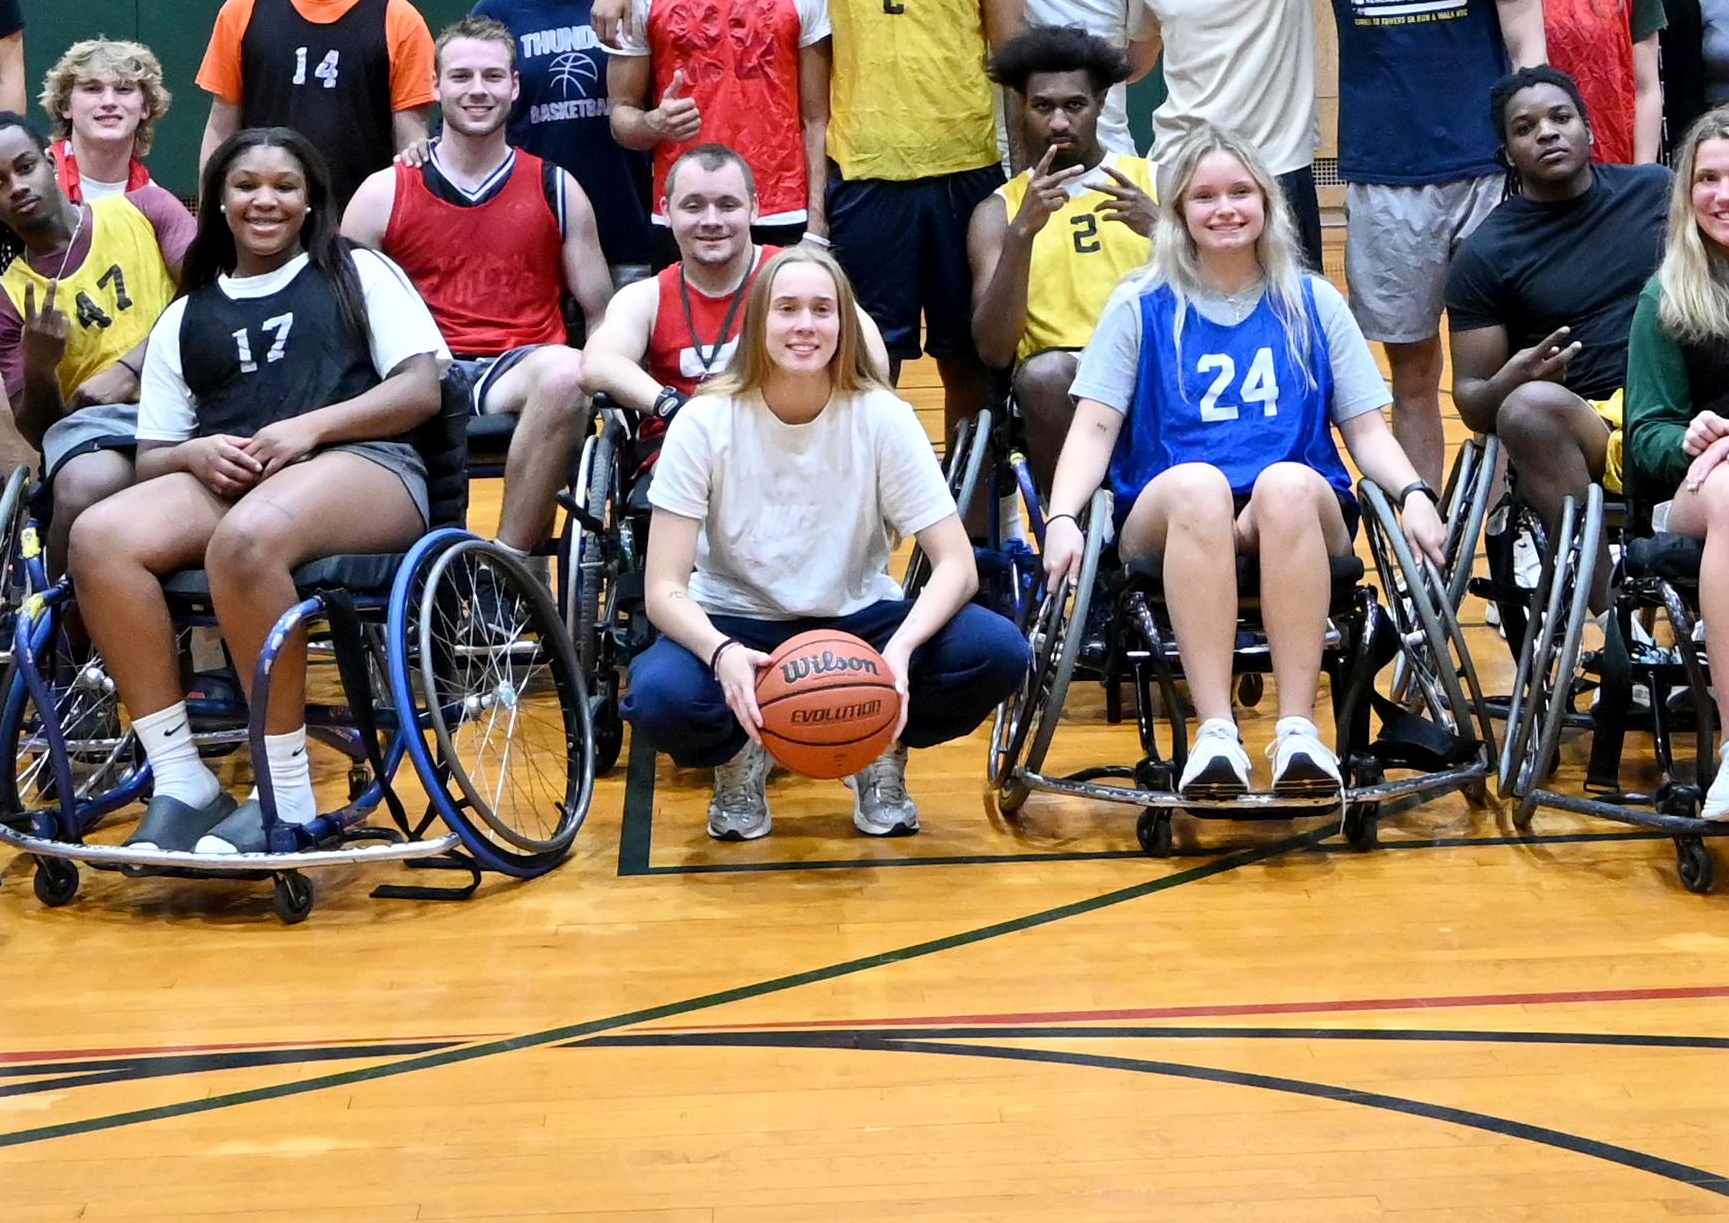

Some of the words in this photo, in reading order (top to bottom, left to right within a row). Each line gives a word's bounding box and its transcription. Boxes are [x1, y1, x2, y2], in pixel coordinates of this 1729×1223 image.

[520, 25, 596, 58] THUND
[292, 46, 339, 88] 14
[530, 98, 609, 124] BASKETBA
[1070, 213, 1101, 253] 2
[75, 263, 133, 329] 47
[232, 311, 294, 373] 17
[1197, 347, 1280, 422] 24
[781, 650, 880, 684] Wilson
[791, 700, 881, 724] EVOLUTION
